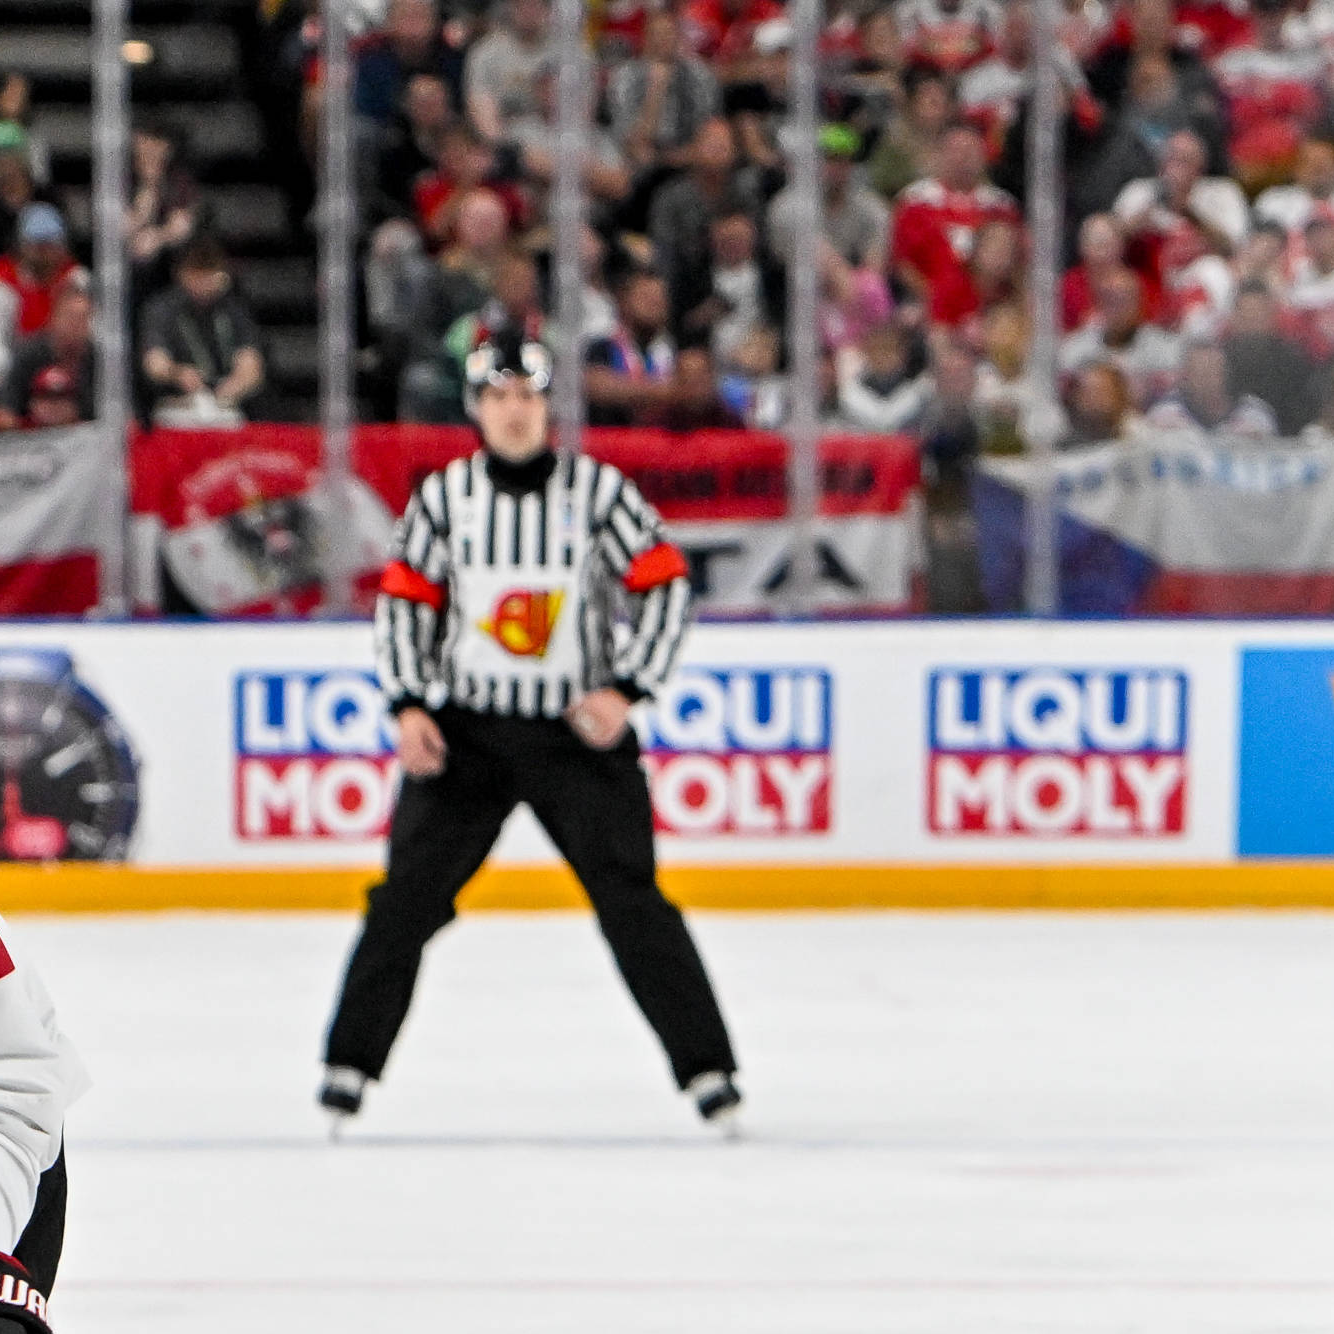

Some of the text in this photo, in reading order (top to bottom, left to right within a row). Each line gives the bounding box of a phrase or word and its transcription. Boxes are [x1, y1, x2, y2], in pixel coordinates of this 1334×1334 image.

[239, 676, 400, 752] LIQ
[639, 676, 827, 750] QUI
[934, 676, 1179, 748] LIQUI
[652, 754, 827, 830] OLY
[934, 754, 1179, 830] MOLY
